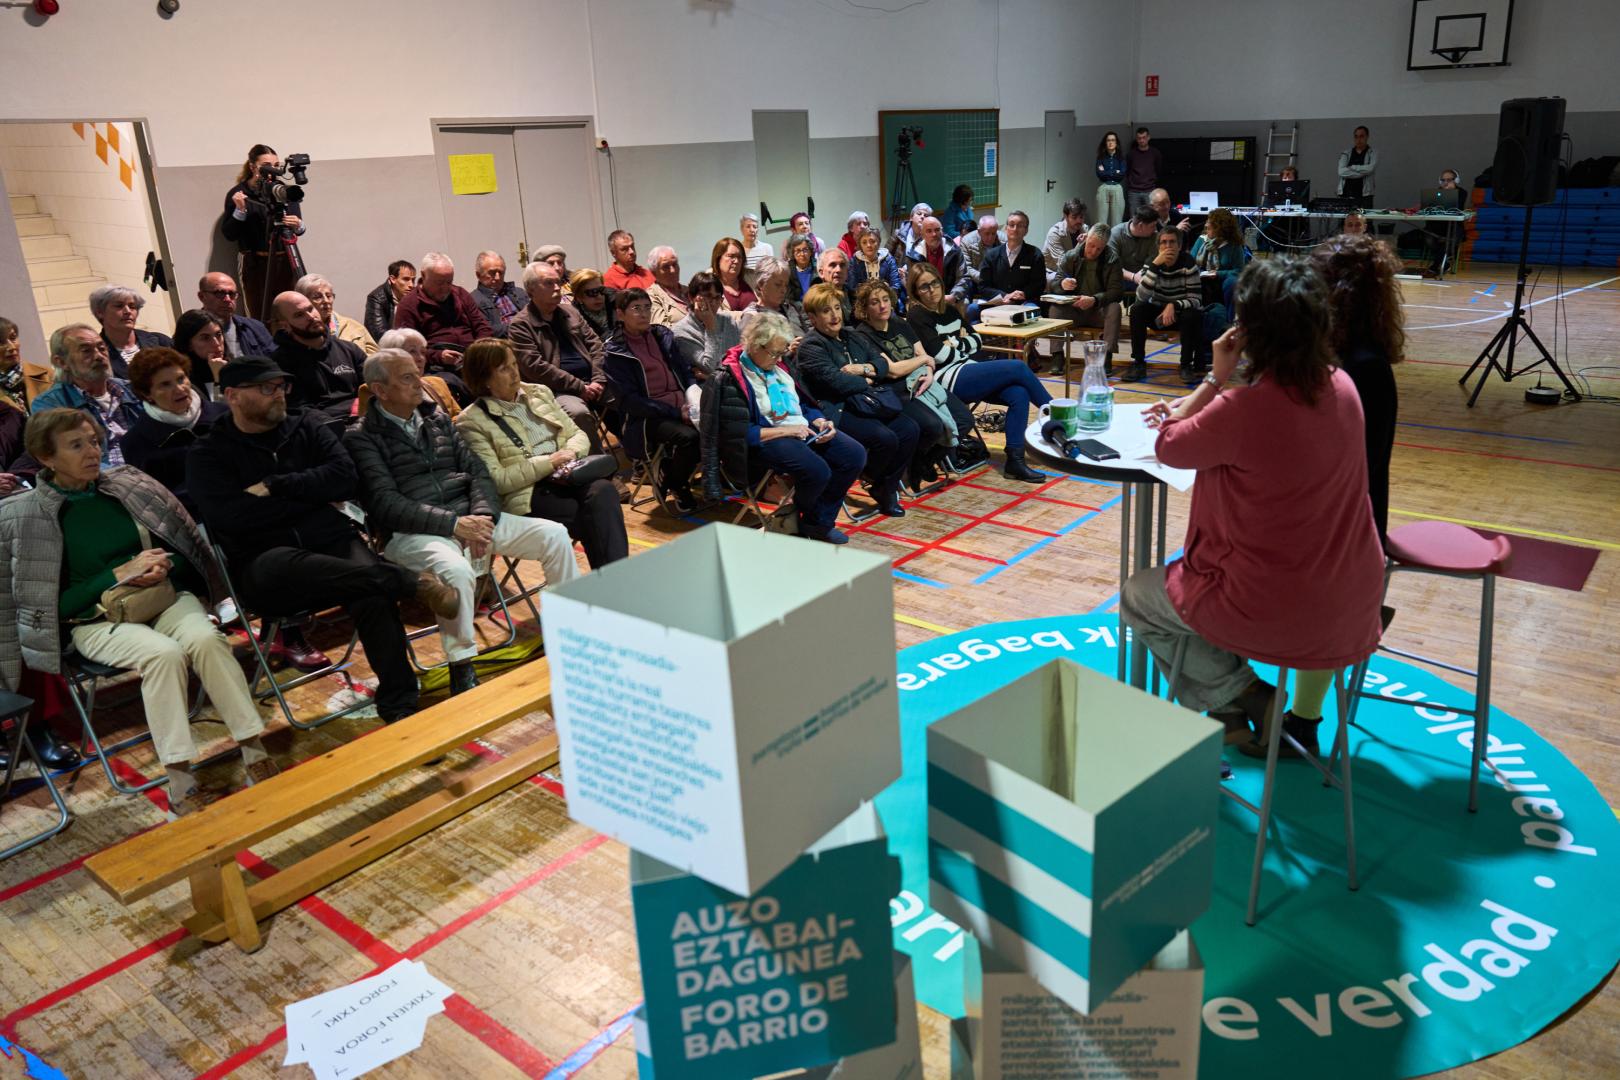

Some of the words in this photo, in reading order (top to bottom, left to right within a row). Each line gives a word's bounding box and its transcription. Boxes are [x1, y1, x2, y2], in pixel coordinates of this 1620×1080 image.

[896, 630, 1075, 690] bagara
[671, 897, 780, 939] AUZO
[673, 913, 855, 968] EZTABAI-
[359, 978, 399, 1006] FORO
[677, 937, 862, 997] DAGUNEA
[1202, 997, 1259, 1040] e
[1276, 899, 1558, 1037] verdad
[324, 1005, 359, 1028] TXIKI
[388, 989, 436, 1024] TXIKIEN
[681, 989, 790, 1032] FORO
[799, 974, 848, 1007] DE
[335, 1021, 387, 1055] FOROA
[684, 1009, 828, 1060] BARRIO
